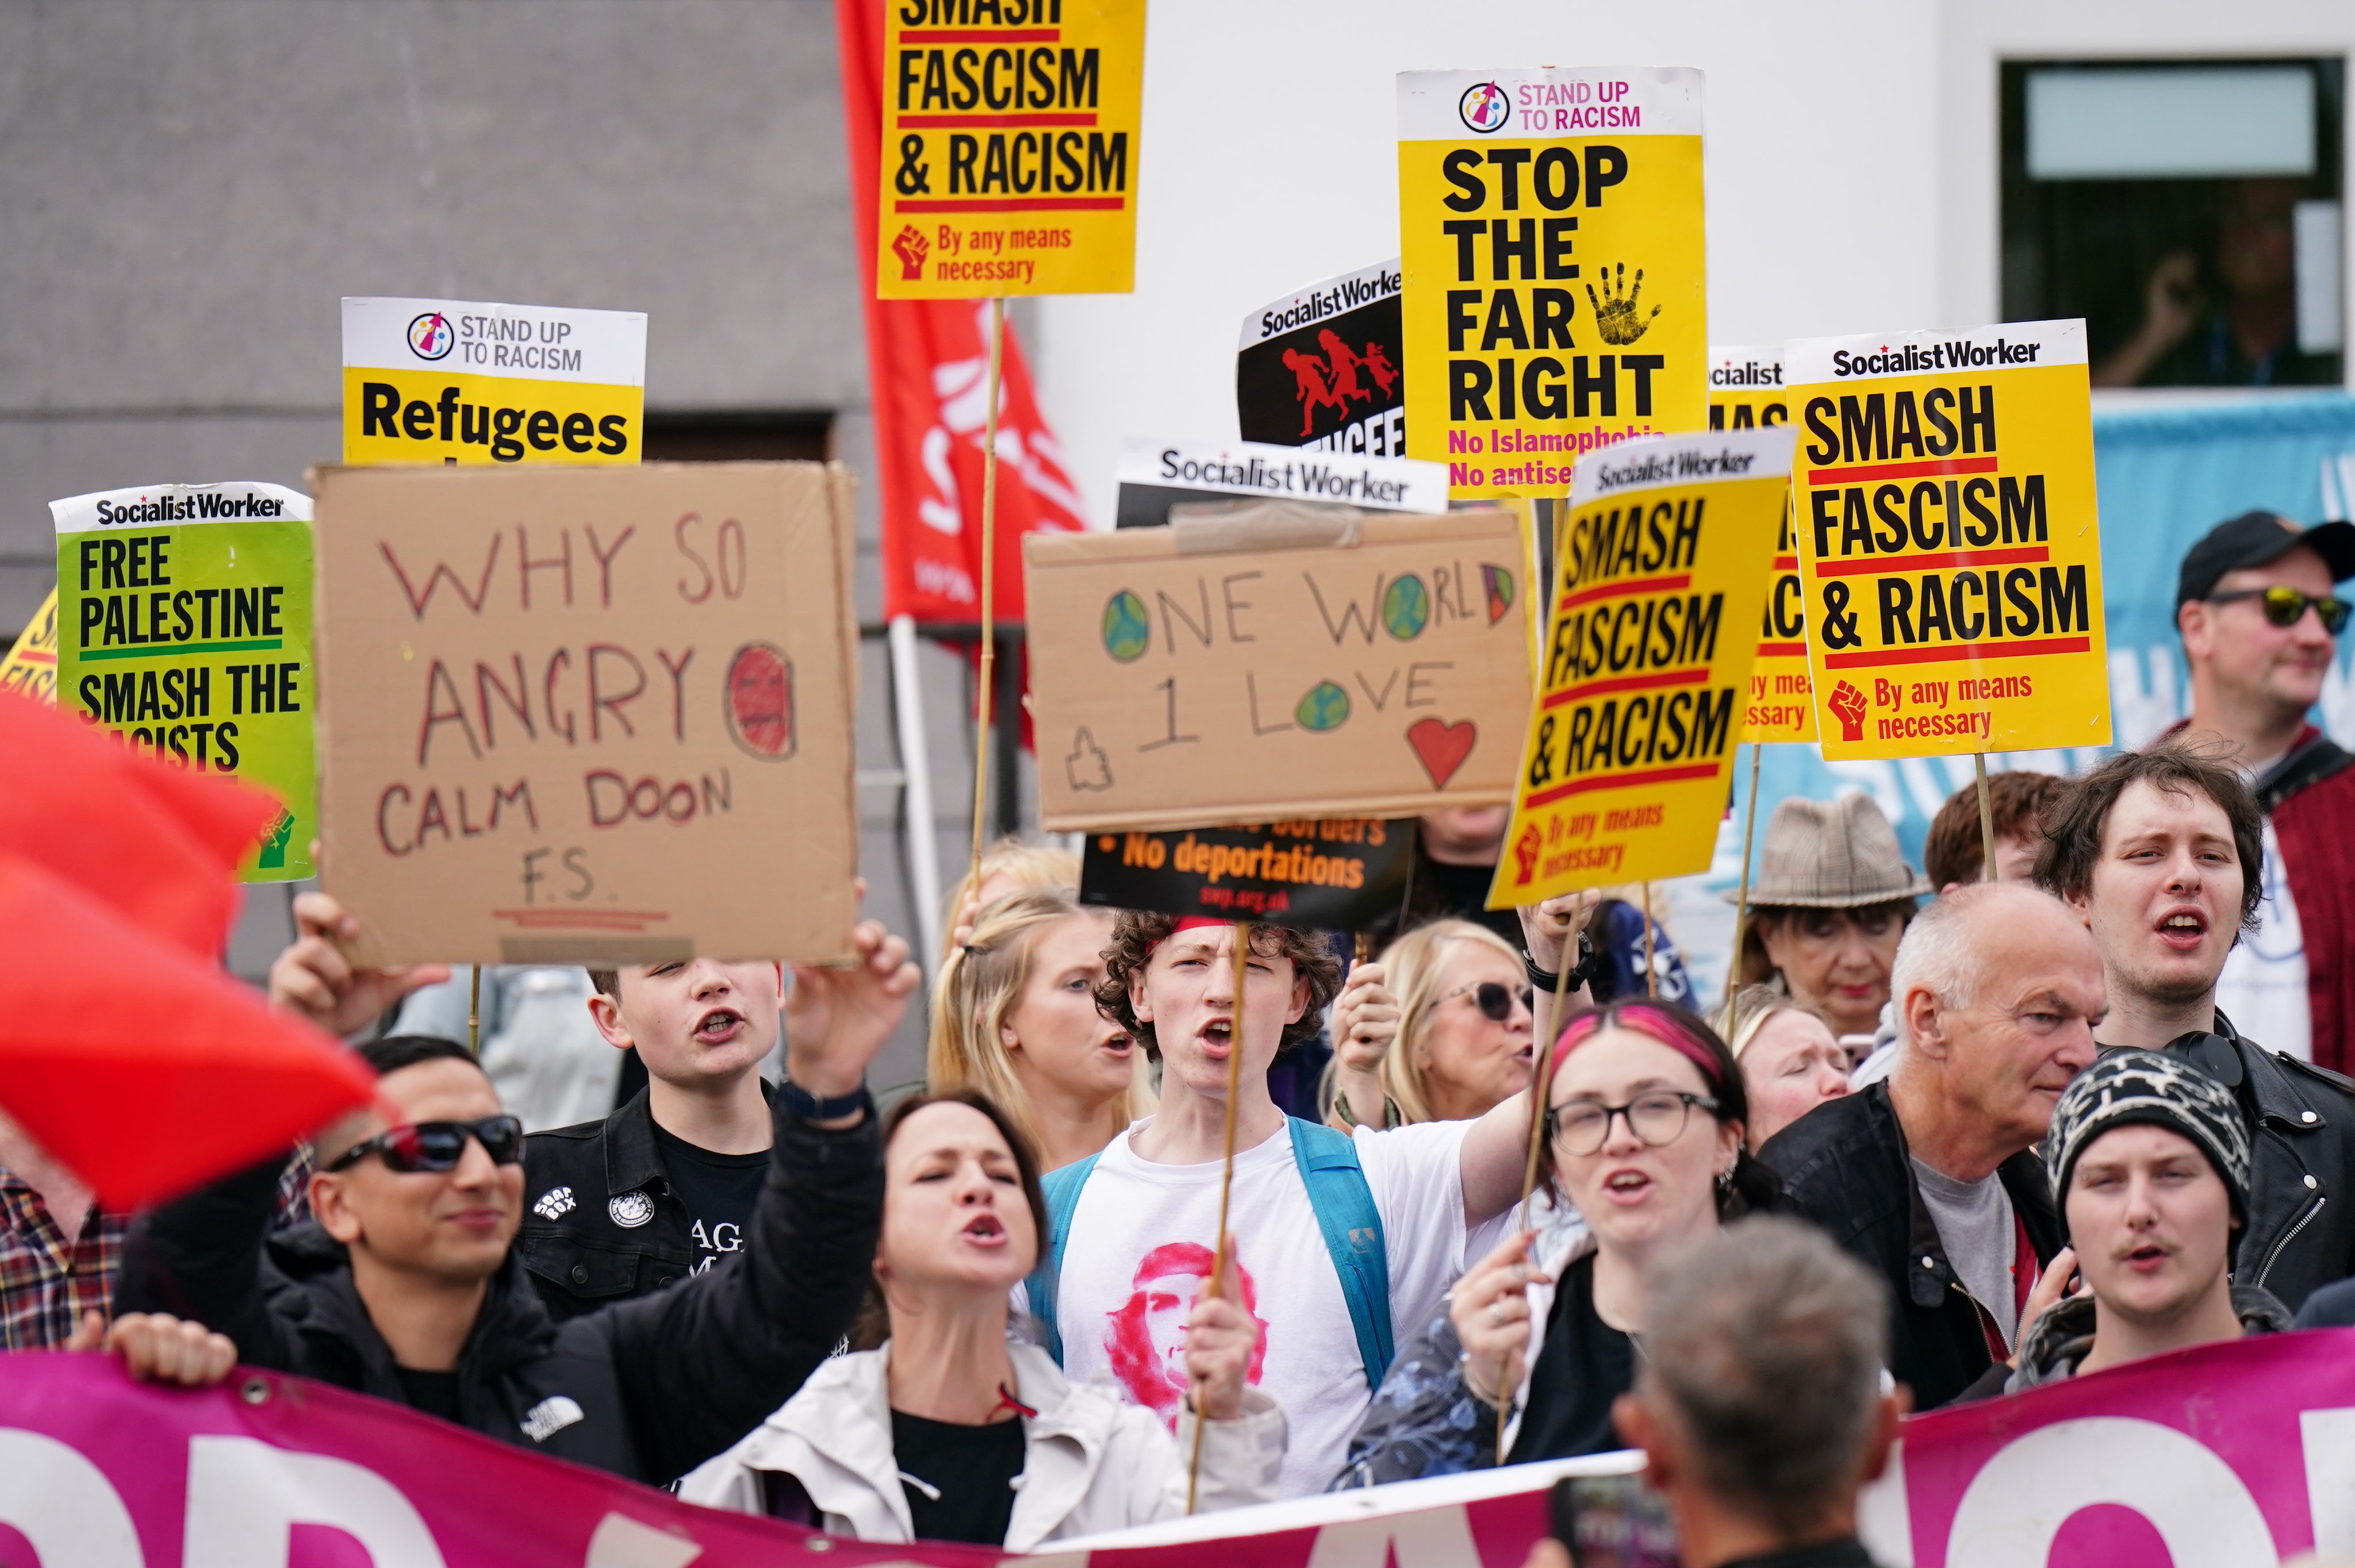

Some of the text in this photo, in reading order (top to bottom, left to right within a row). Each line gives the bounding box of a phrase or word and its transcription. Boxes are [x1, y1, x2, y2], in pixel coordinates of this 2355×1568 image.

[898, 48, 1099, 110] FASCISM
[1519, 82, 1628, 106] STAND UP
[1520, 106, 1640, 130] TO RACISM
[895, 132, 1127, 194] & RACISM
[1443, 145, 1628, 212] STOP
[938, 224, 1071, 255] By any means
[1443, 217, 1579, 281] THE
[938, 260, 1035, 285] necessary
[461, 316, 571, 344] STAND UP
[1261, 270, 1401, 337] Socialist Worke
[1447, 289, 1575, 351] FAR
[461, 341, 581, 371] TO RACISM
[1709, 362, 1782, 385] cialist
[1834, 339, 2040, 376] Socialist Worker
[1449, 355, 1664, 421] RIGHT
[363, 382, 627, 462] Refugees
[1449, 430, 1483, 454] No
[1804, 385, 1996, 465] SMASH
[1161, 450, 1411, 503] Socialist Worker
[1450, 460, 1577, 486] No antise
[1598, 449, 1755, 491] Socialist Worker
[97, 493, 284, 525] Socialist Worker
[1811, 475, 2048, 557] FASCISM
[80, 536, 170, 590] FREE
[378, 513, 747, 620] WHY SO
[1567, 499, 1705, 589] SMASH
[80, 587, 283, 647] PALESTINE
[1102, 561, 1513, 662] ONE WORLD
[1821, 581, 1862, 650] &
[1878, 564, 2089, 645] RACISM
[1548, 594, 1724, 687] FASCISM
[79, 667, 209, 725] SMASH
[226, 663, 300, 714] THE
[417, 644, 696, 768] ANGRY
[1138, 662, 1455, 752] 1 LOVE
[1875, 675, 2032, 712] By any means
[1530, 689, 1735, 787] & RACISM
[1878, 710, 1991, 740] necessary
[377, 768, 731, 857] CALM DOON
[1568, 813, 1598, 842] any
[1603, 804, 1664, 831] means
[1123, 833, 1364, 889] No deportations
[1543, 844, 1625, 880] necessary
[534, 1187, 572, 1215] SOAP
[546, 1197, 576, 1220] BOX
